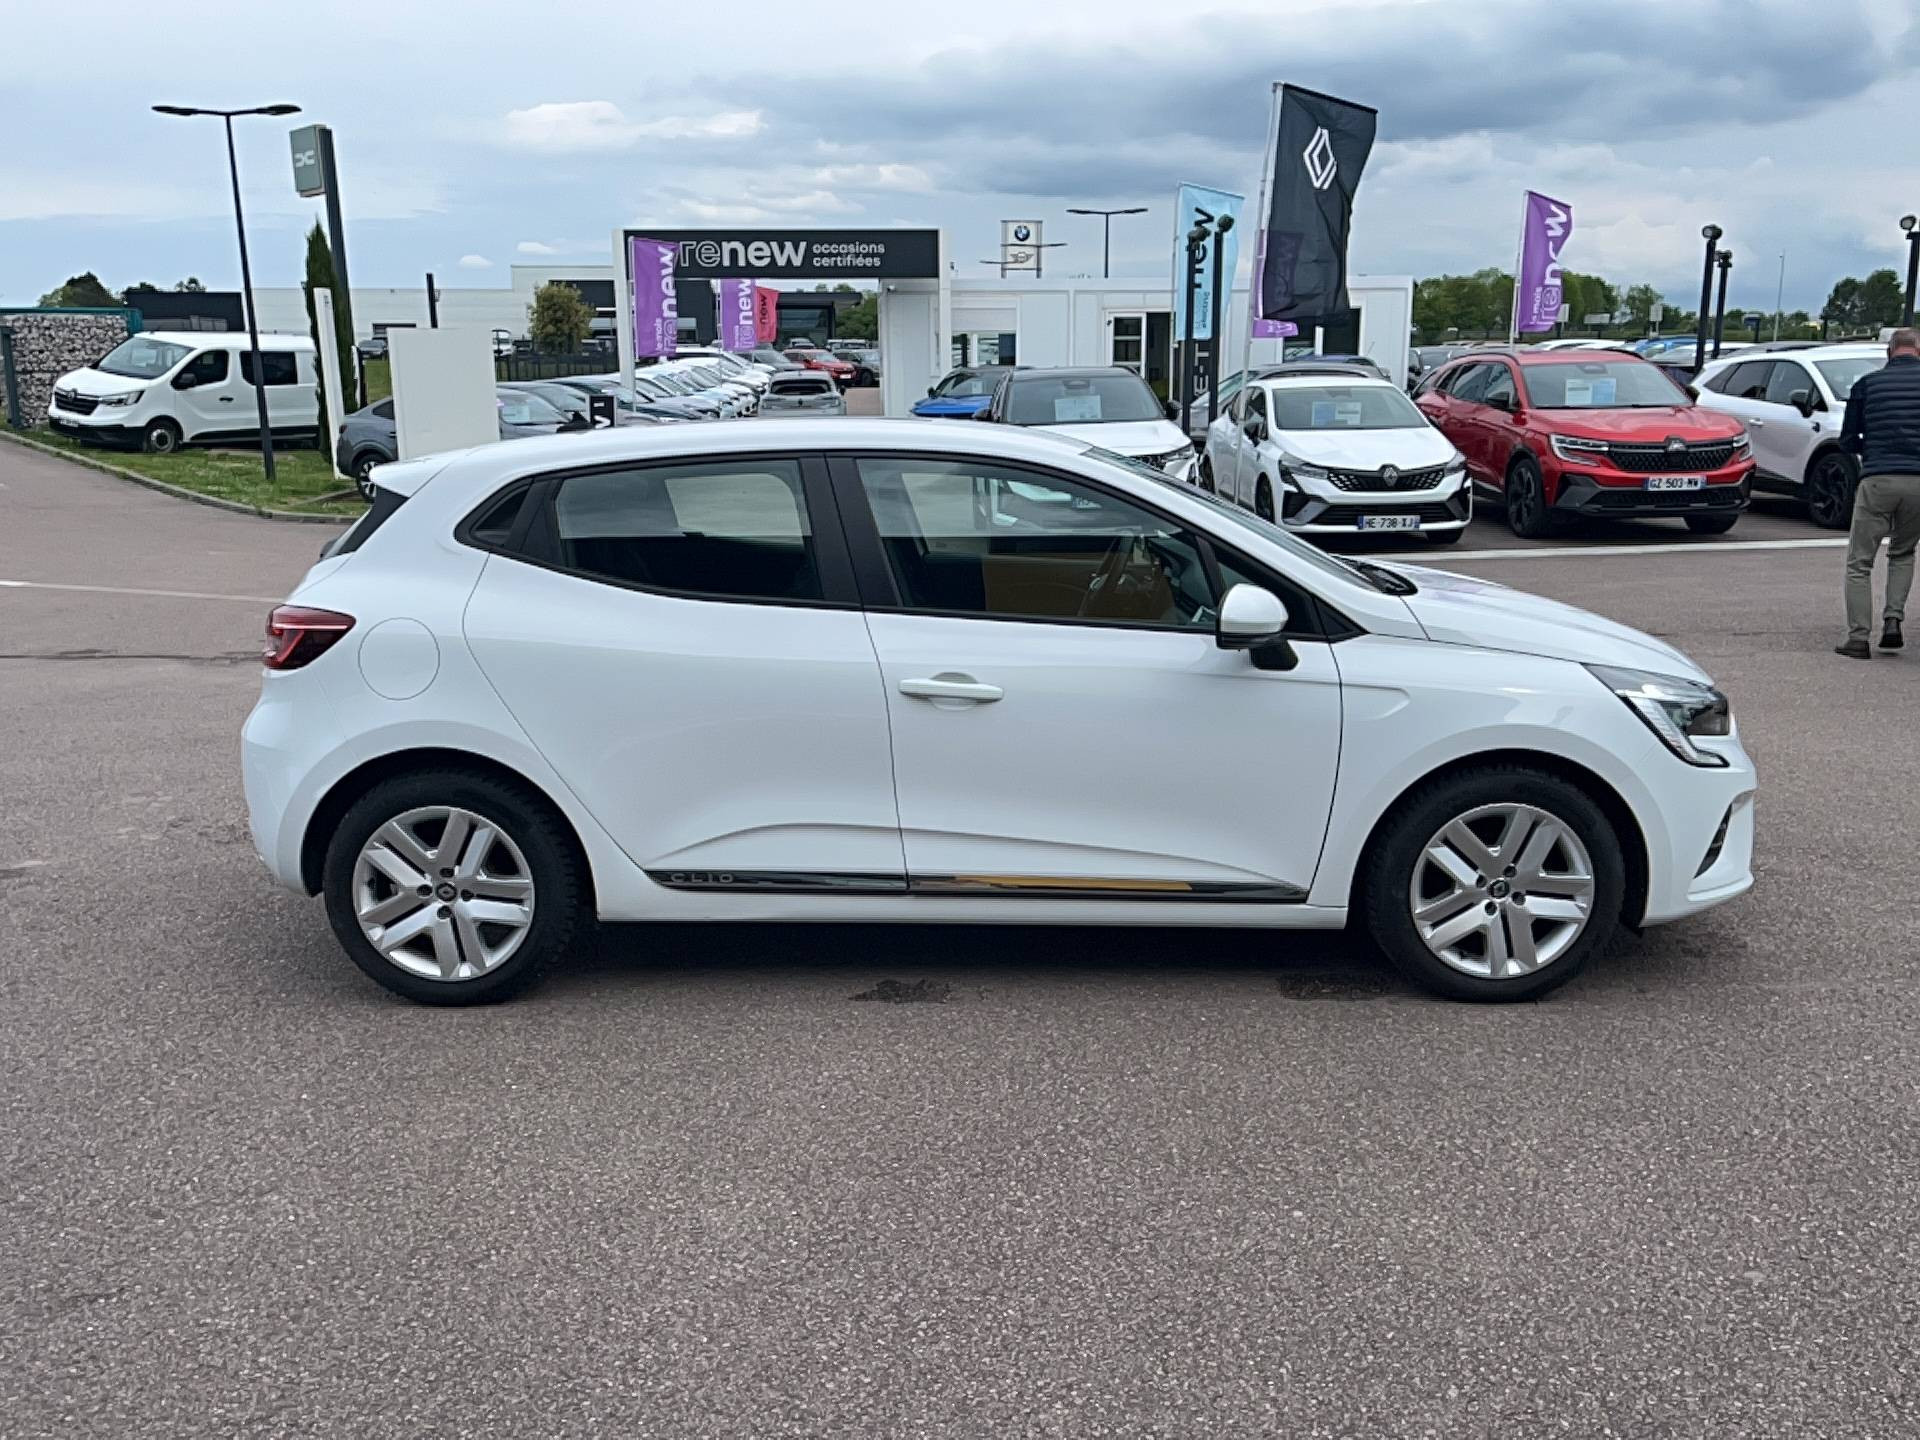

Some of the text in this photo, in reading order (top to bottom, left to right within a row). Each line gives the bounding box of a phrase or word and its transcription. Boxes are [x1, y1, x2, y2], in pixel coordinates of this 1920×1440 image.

[680, 241, 807, 267] renew
[812, 241, 885, 254] occasions
[812, 254, 881, 267] certifiées
[670, 872, 734, 883] CLIO
